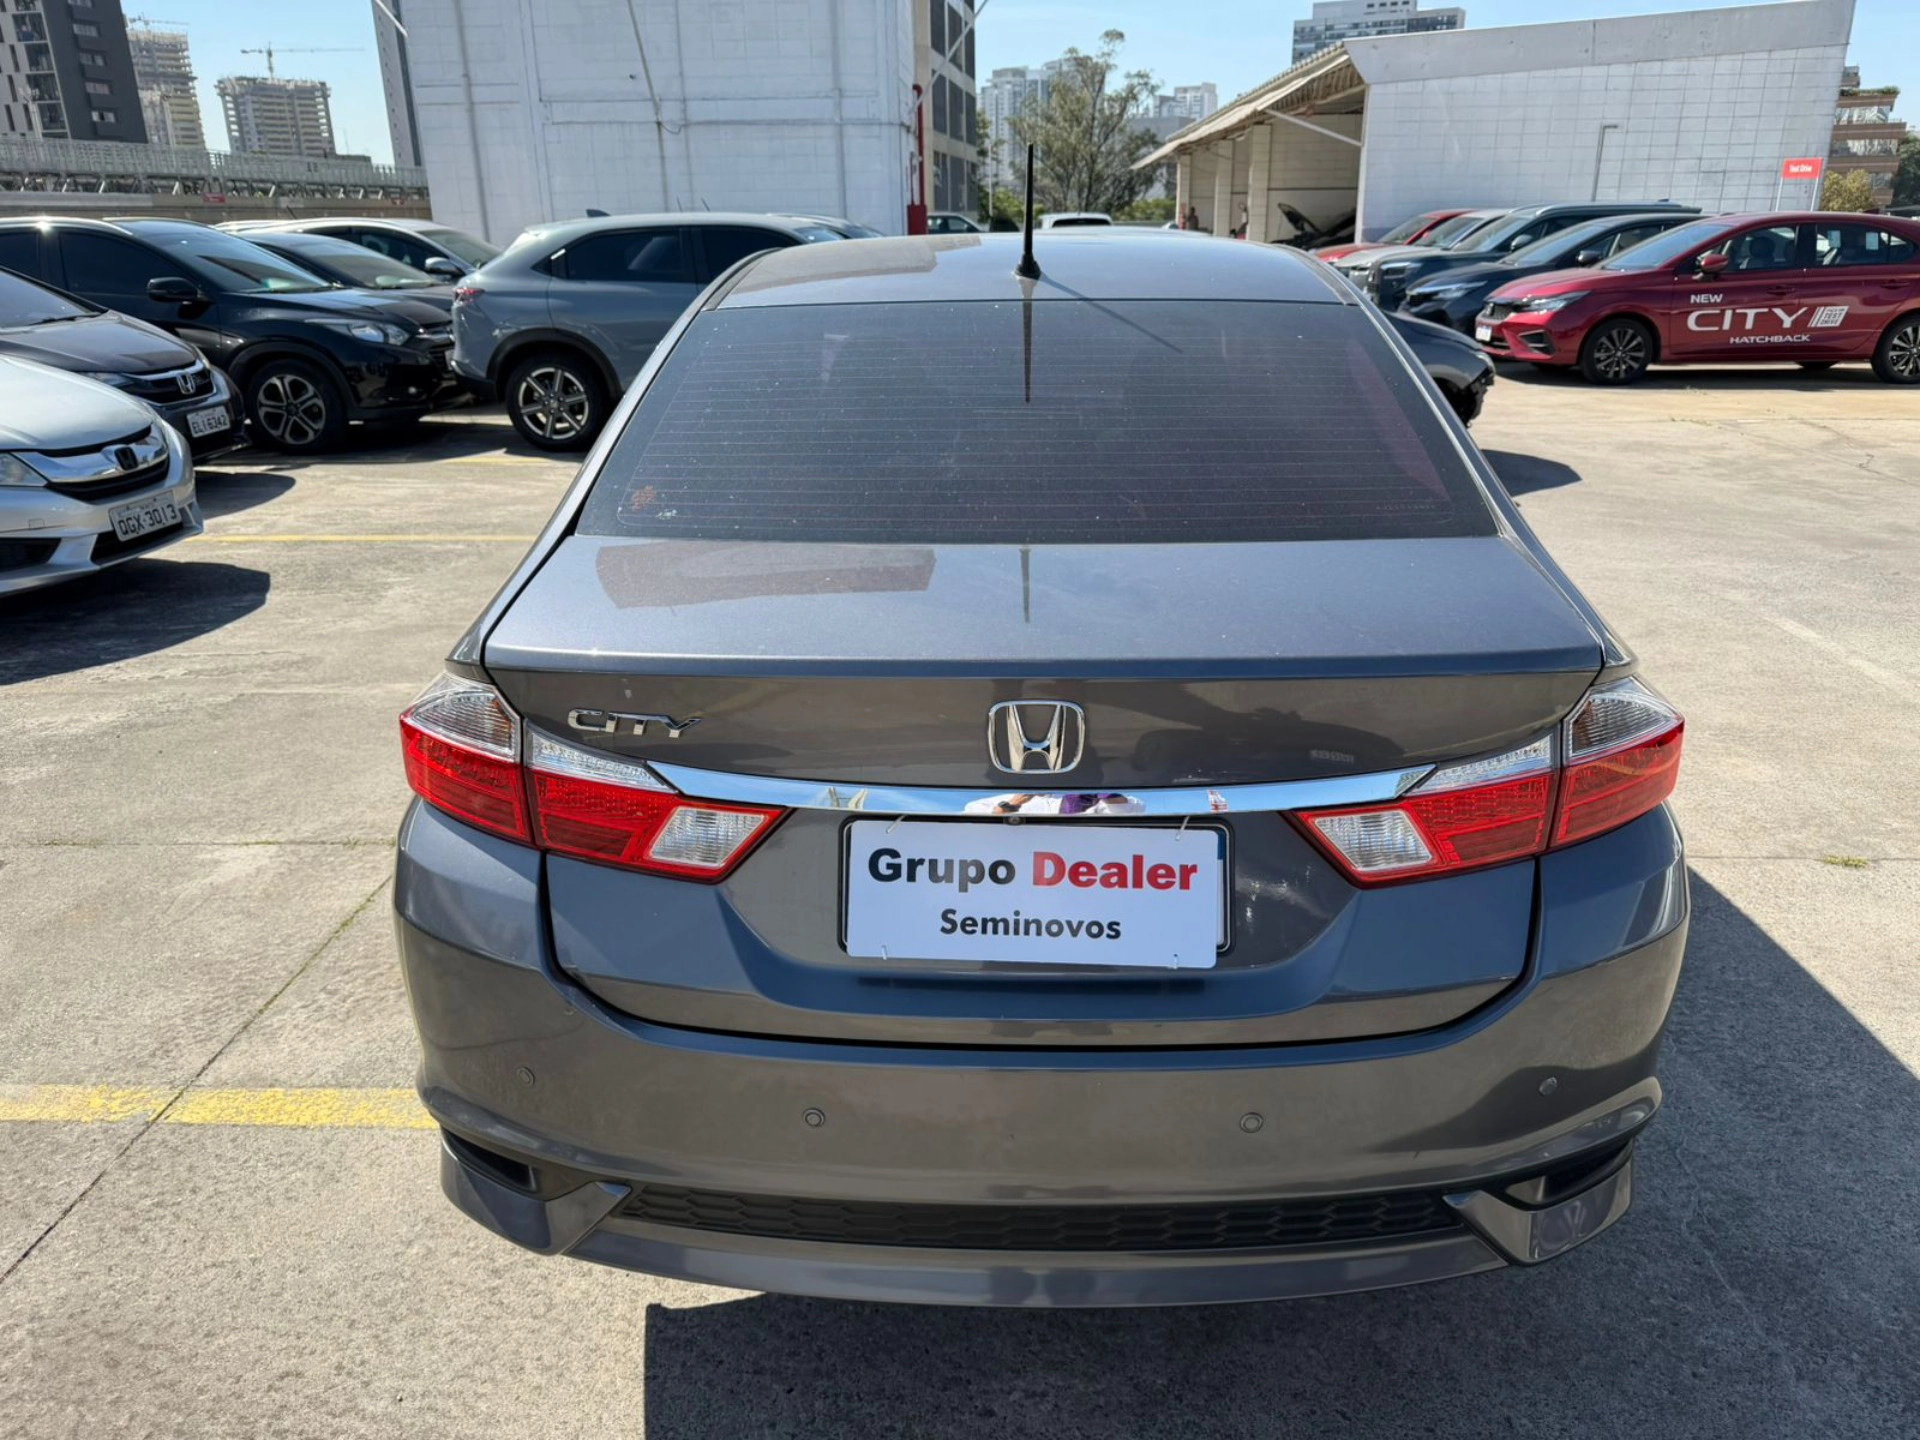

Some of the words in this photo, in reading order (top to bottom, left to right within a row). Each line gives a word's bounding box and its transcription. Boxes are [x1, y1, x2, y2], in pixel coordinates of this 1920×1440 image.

[1690, 294, 1723, 304] NEW
[1687, 307, 1808, 331] CITY
[1730, 334, 1810, 344] HATCHBACK
[568, 708, 701, 738] CITY
[868, 848, 1016, 893] Grupo
[1032, 851, 1198, 890] Dealer
[940, 908, 1122, 939] Seminovos
